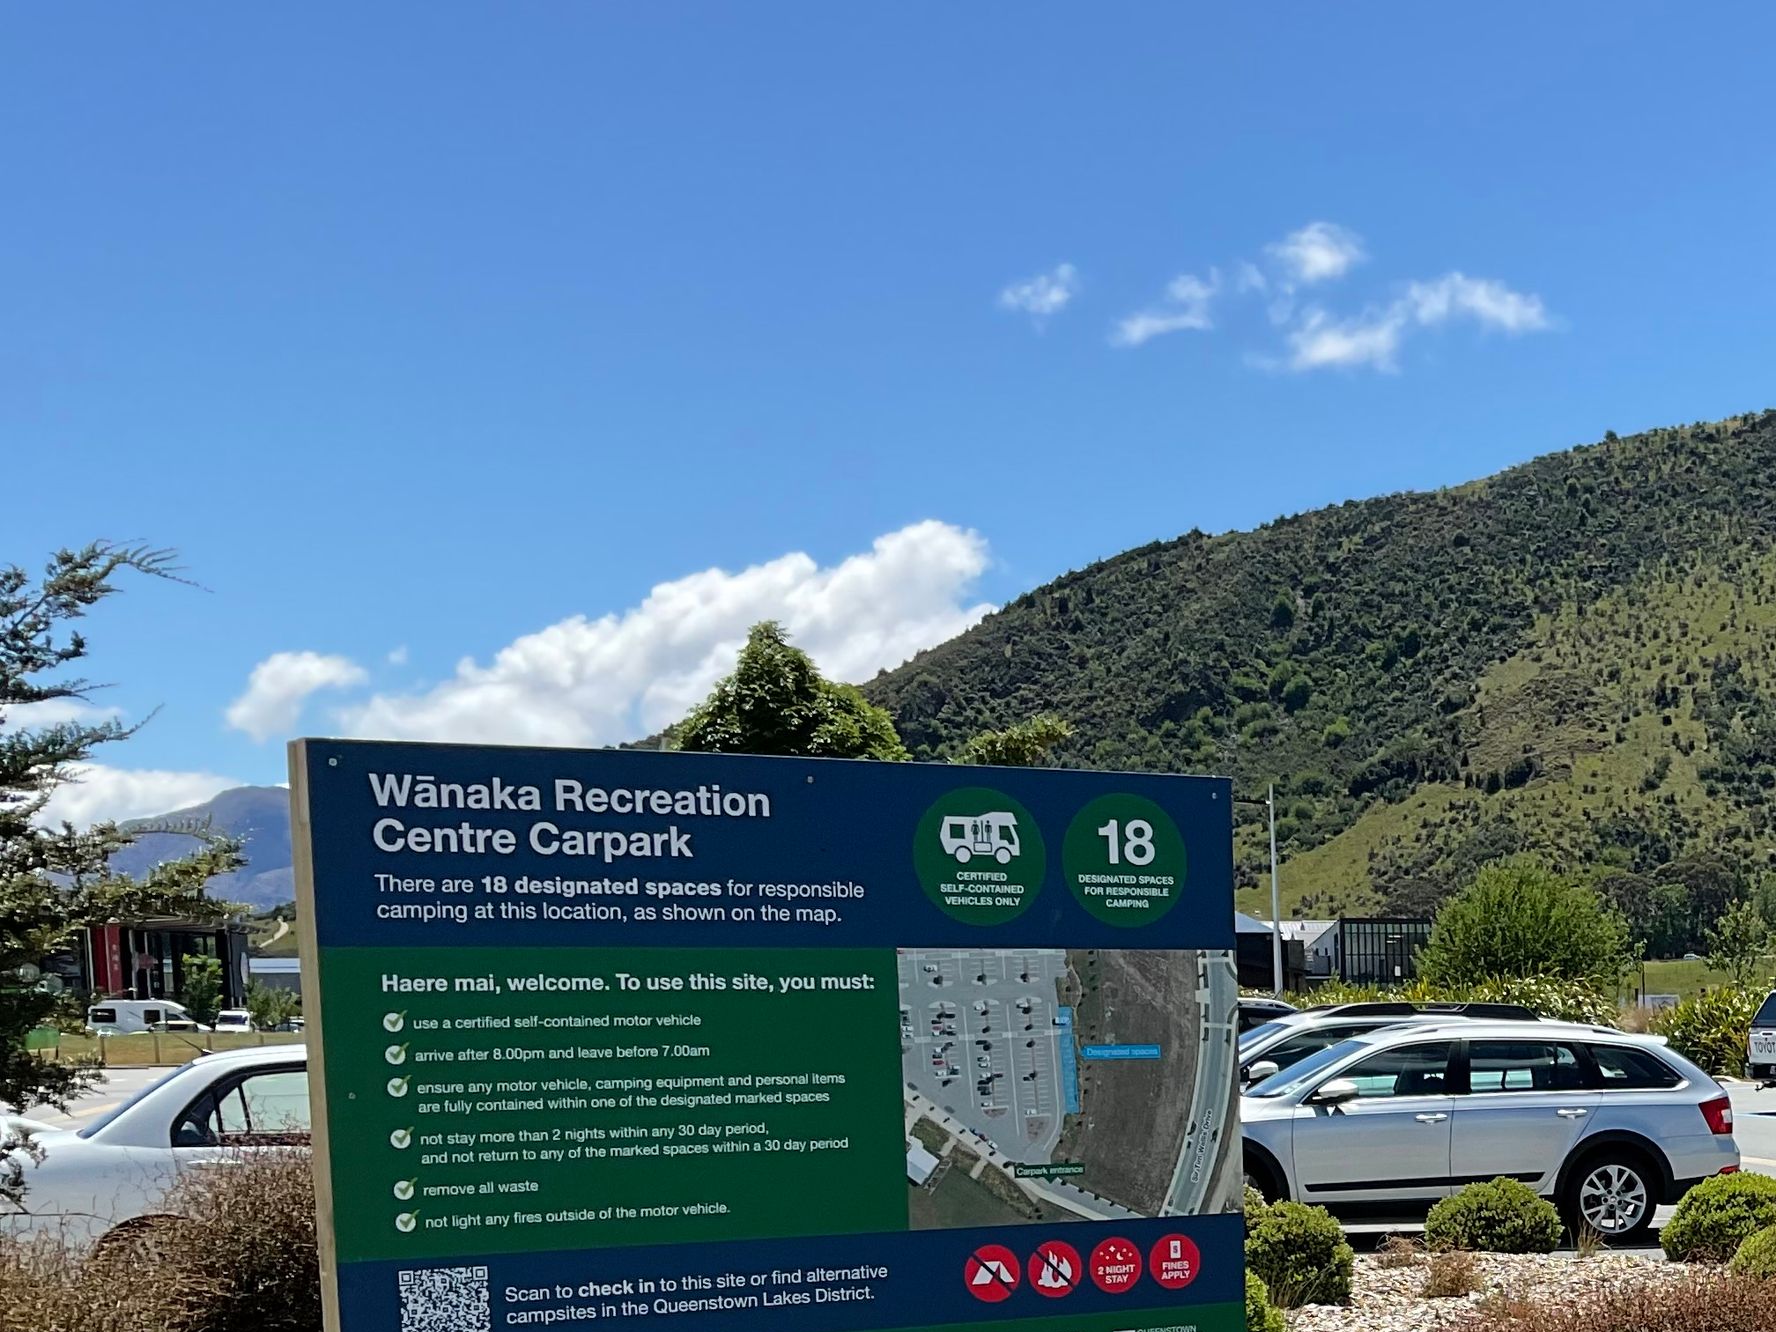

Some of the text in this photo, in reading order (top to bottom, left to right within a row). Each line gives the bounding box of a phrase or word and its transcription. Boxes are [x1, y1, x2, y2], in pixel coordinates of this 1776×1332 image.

[369, 773, 770, 817] Wānaka Recreation
[373, 818, 693, 863] Centre Carpark
[1098, 819, 1155, 865] 18
[956, 871, 1007, 881] CERTIFIED
[1078, 874, 1174, 885] DESIGNATED SPACES
[374, 874, 864, 901] There are 18 designated spaces for responsible
[940, 883, 1024, 894] SELF-CONTAINED
[1084, 886, 1169, 897] FOR RESPONSIBLE
[945, 896, 1020, 906] VEHICLES ONLY
[1106, 899, 1149, 908] CAMPING
[377, 901, 842, 925] camping at this location, as shown on the map.
[382, 973, 875, 994] Haere mai, welcome. To use this site, you must:
[413, 1014, 701, 1029] use a certified self-contained motor vehicle
[415, 1045, 710, 1062] arrive after 8.00pm and leave before 7.00am
[417, 1073, 846, 1095] ensure any motor vehicle, camping equipment and personal items
[418, 1091, 830, 1115] are fully contained within one of the designated marked spaces
[420, 1122, 769, 1146] not stay more than 2 nights within any 30 day period,
[423, 1180, 539, 1196] remove all waste
[425, 1202, 730, 1229] not light any fires outside of the motor vehicle.
[1098, 1264, 1135, 1275] 2 NIGHT
[1162, 1261, 1189, 1270] FINES
[505, 1265, 888, 1302] Scan to check in to this site or find alternative
[1105, 1274, 1128, 1284] STAY
[1161, 1270, 1190, 1280] APPLY
[507, 1286, 874, 1325] campsites in the Queenstown Lakes District.
